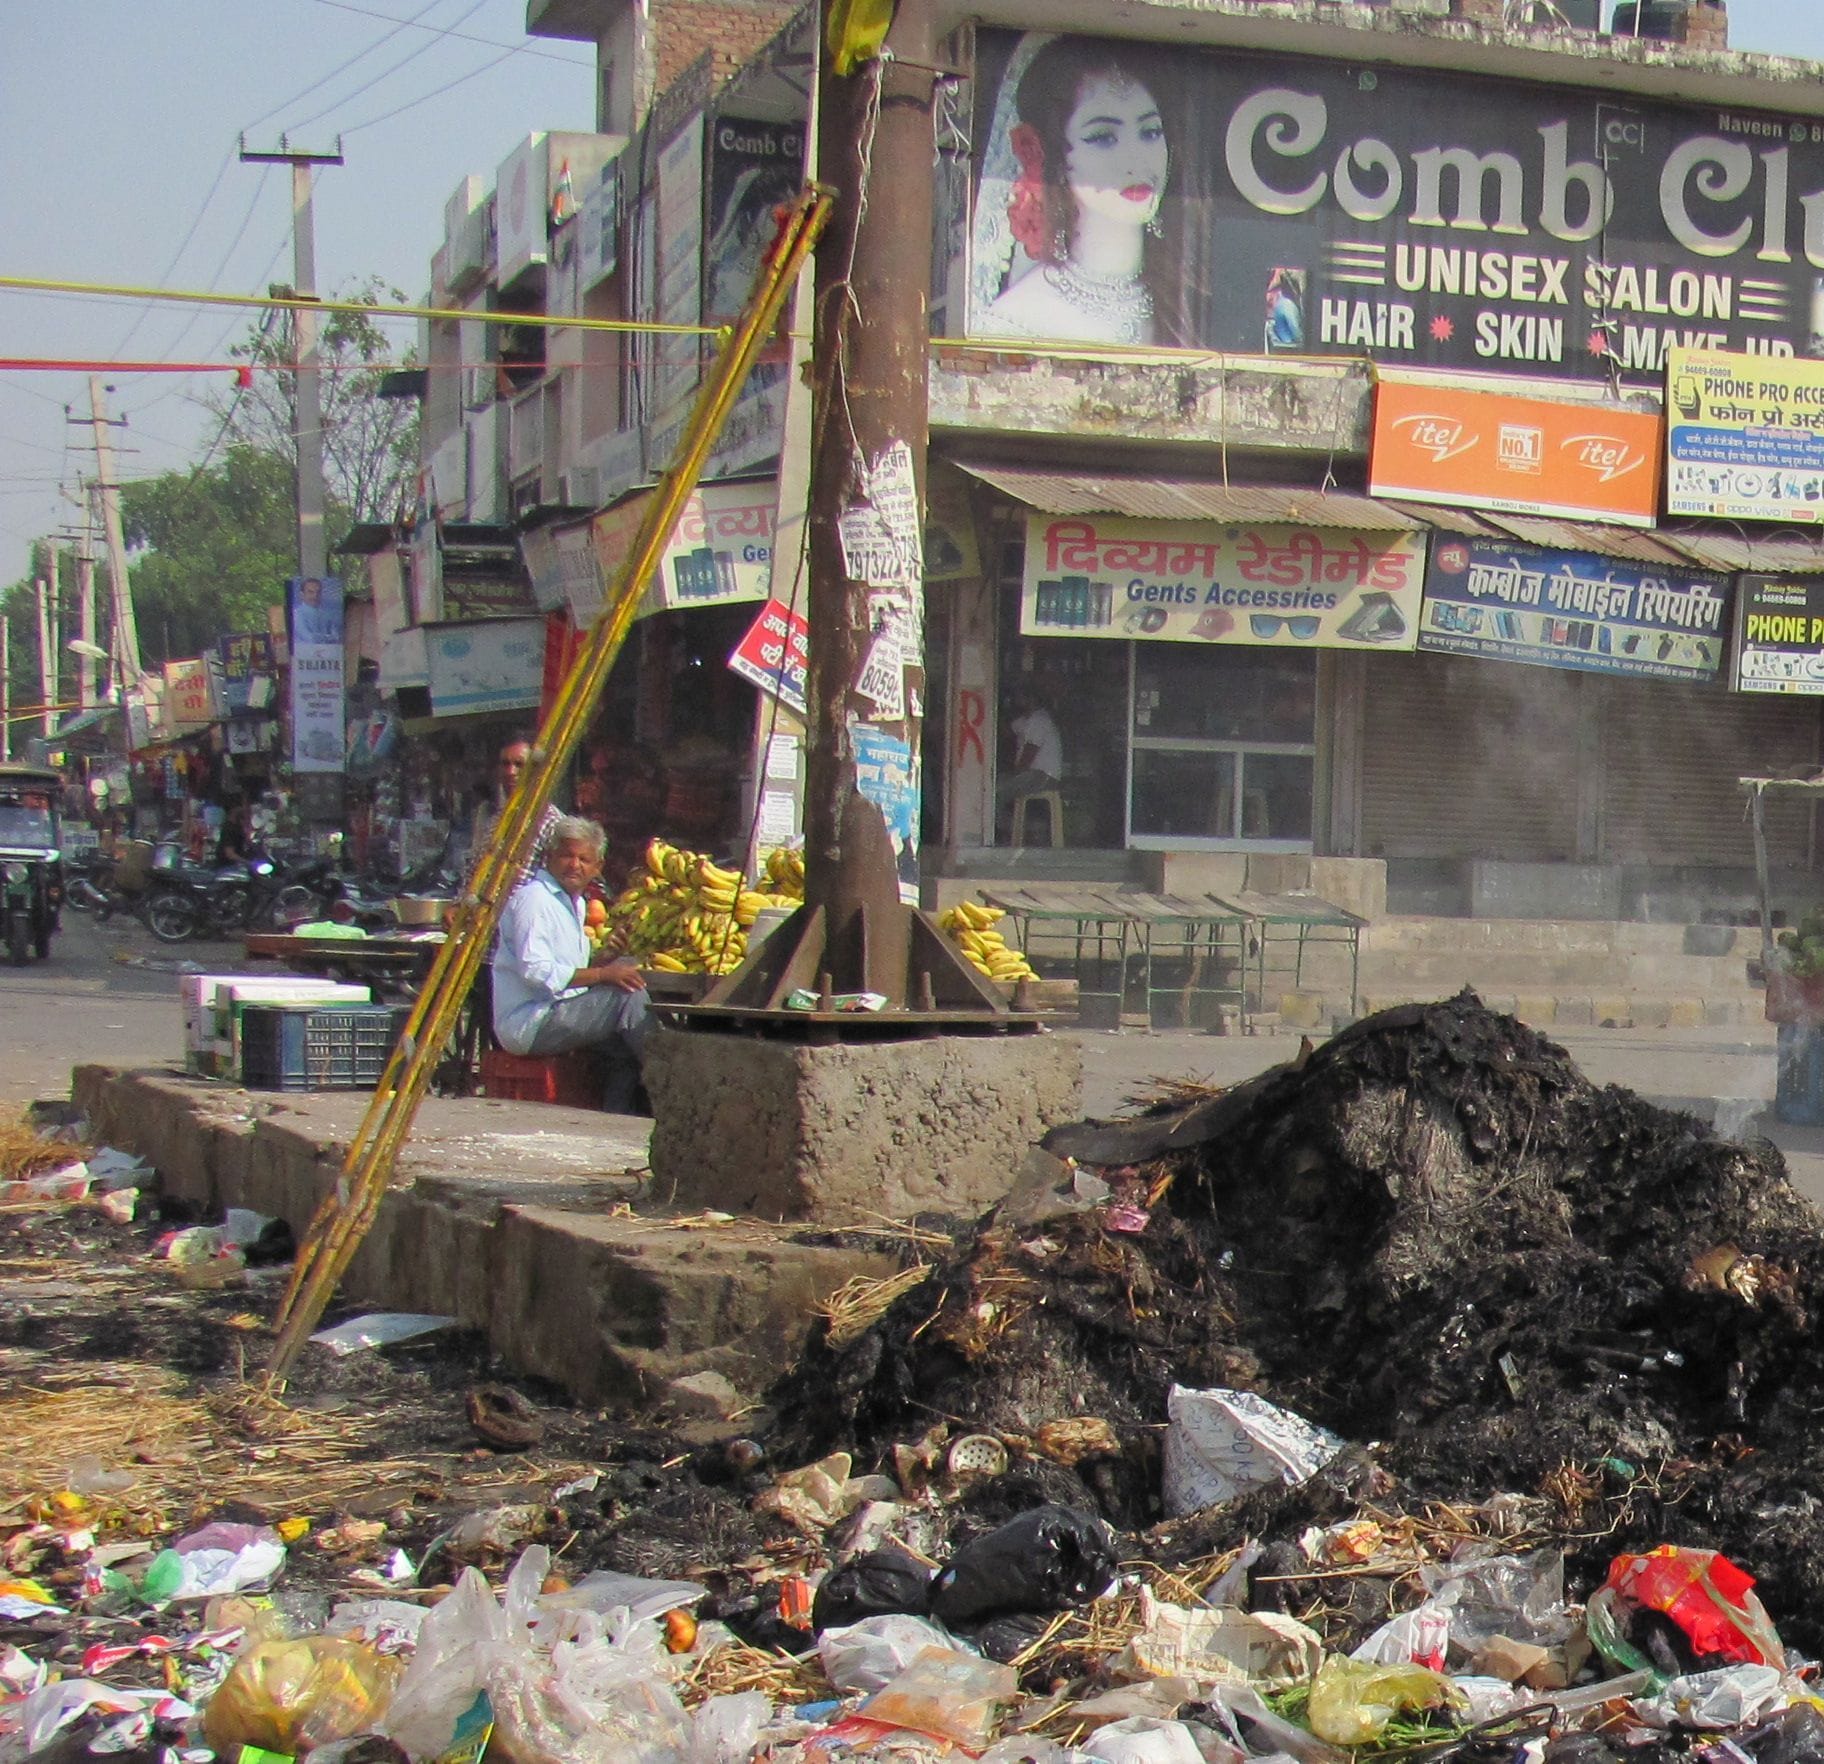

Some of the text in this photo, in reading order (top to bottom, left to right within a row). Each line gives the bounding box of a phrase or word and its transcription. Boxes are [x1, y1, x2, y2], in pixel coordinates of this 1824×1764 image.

[1718, 114, 1783, 138] Naveen
[781, 133, 804, 159] Cl
[1225, 87, 1615, 243] Comb
[1395, 245, 1732, 320] UNISEX SALON
[1321, 298, 1415, 350] HAIR
[1475, 312, 1563, 364] SKIN
[1704, 377, 1754, 401] PHONE
[1759, 382, 1789, 404] PRO
[1709, 401, 1755, 423] फोन
[1761, 405, 1784, 427] प्रो
[1502, 433, 1539, 459] NO.1
[1042, 521, 1415, 591] दिव्यम रेडीमेड
[1126, 577, 1337, 611] Gents Accessries
[1467, 556, 1546, 606] कम्बोज
[1548, 563, 1635, 620] मोबाईल
[1746, 613, 1806, 645] PHONE
